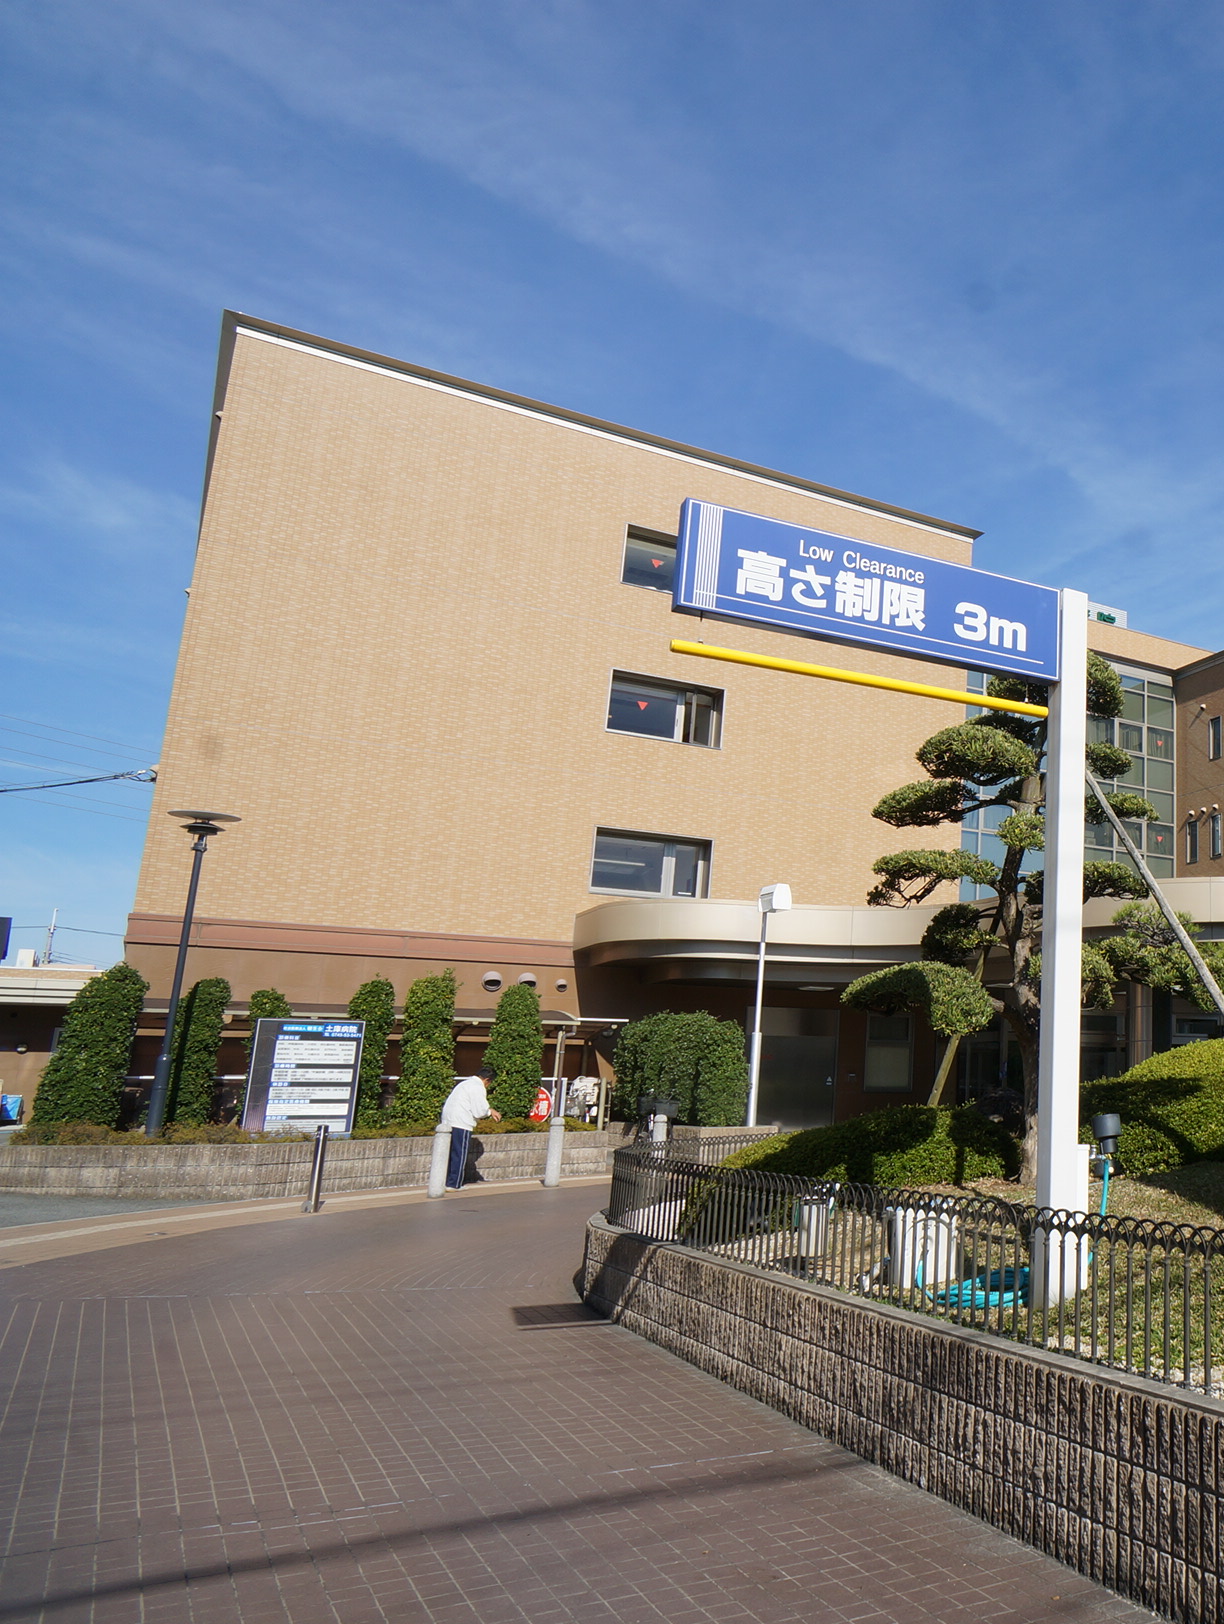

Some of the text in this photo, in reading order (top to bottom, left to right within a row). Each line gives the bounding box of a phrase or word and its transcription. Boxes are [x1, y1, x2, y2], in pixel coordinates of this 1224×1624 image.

[799, 539, 925, 585] Low Clearance
[735, 548, 1027, 652] 高さ制限 3m
